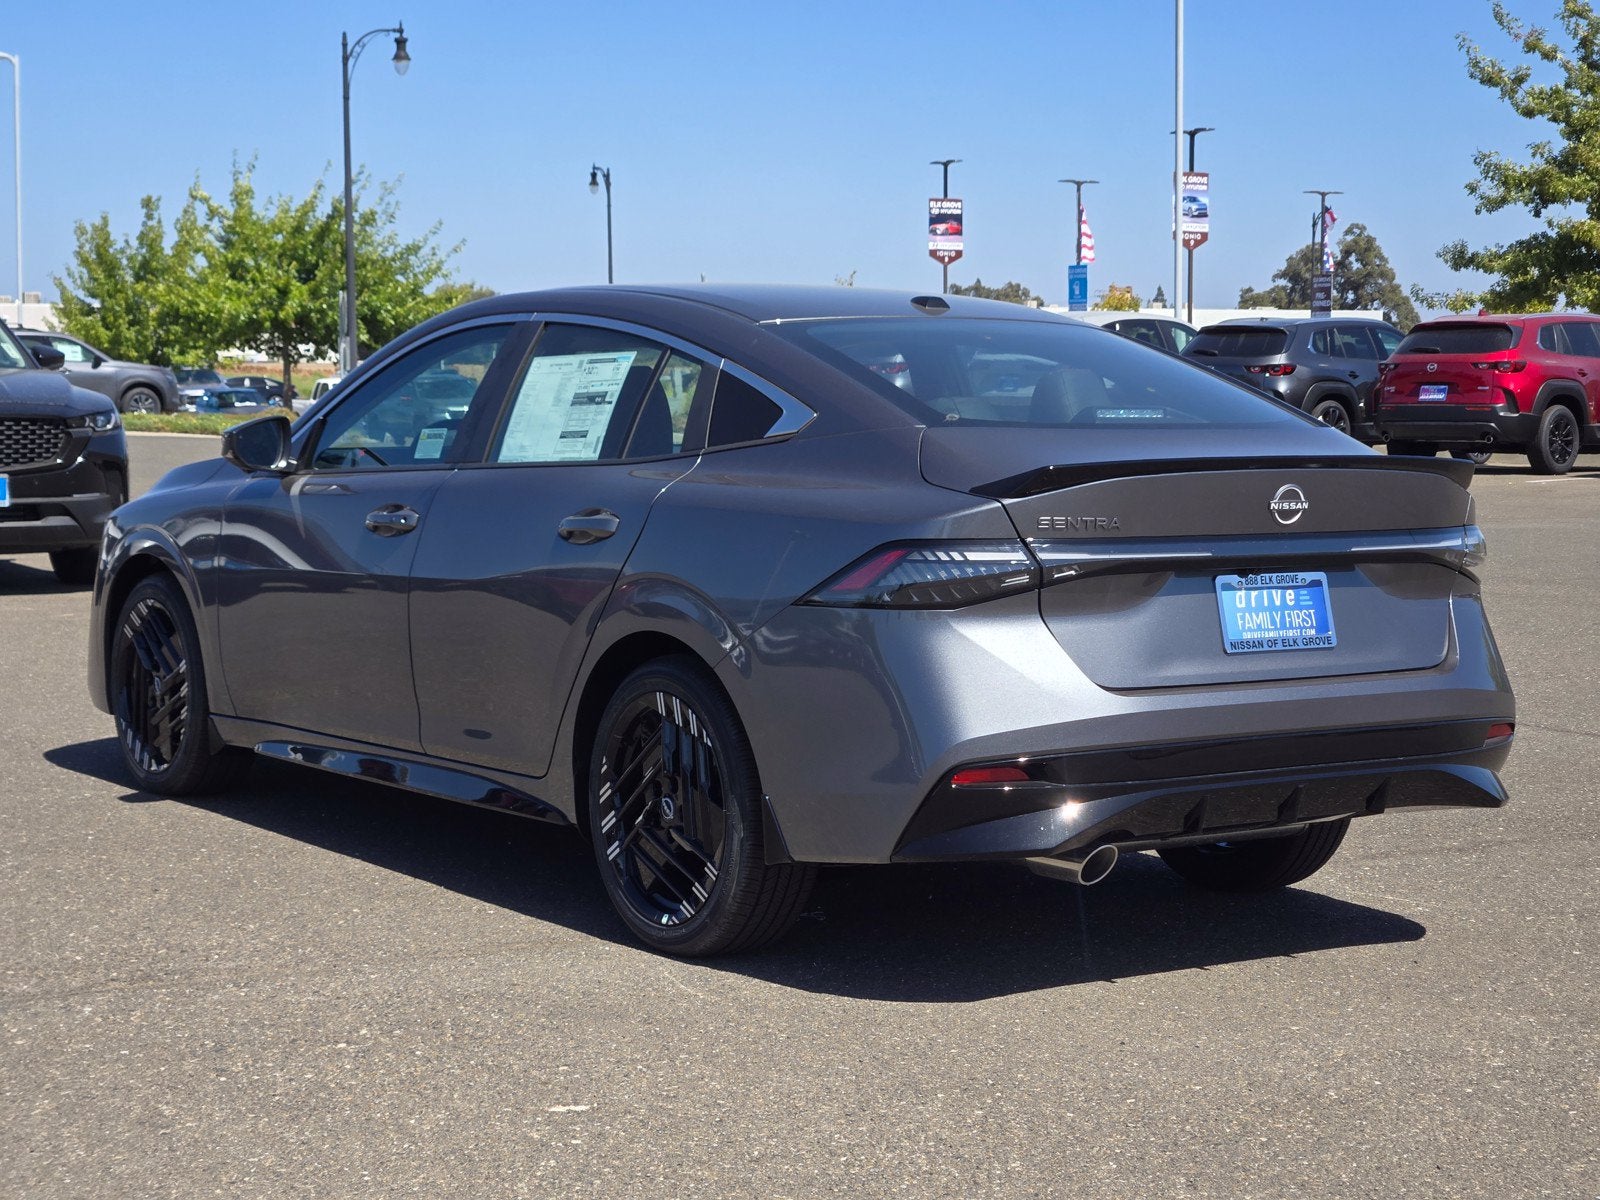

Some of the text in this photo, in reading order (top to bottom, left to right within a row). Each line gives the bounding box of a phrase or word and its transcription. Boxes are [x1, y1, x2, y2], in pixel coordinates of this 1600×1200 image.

[1188, 176, 1208, 184] GROVE
[1270, 500, 1309, 511] NISSAN
[1036, 515, 1121, 531] SENTRA
[1260, 575, 1274, 585] ELK
[1275, 574, 1299, 584] GROVE
[1236, 588, 1295, 608] drive
[1237, 609, 1317, 630] FAMILY FIRST
[1242, 629, 1316, 639] DRIVEFAMILYFIRSTCOM
[1230, 636, 1333, 651] NISSAN OF ELK GROVE
